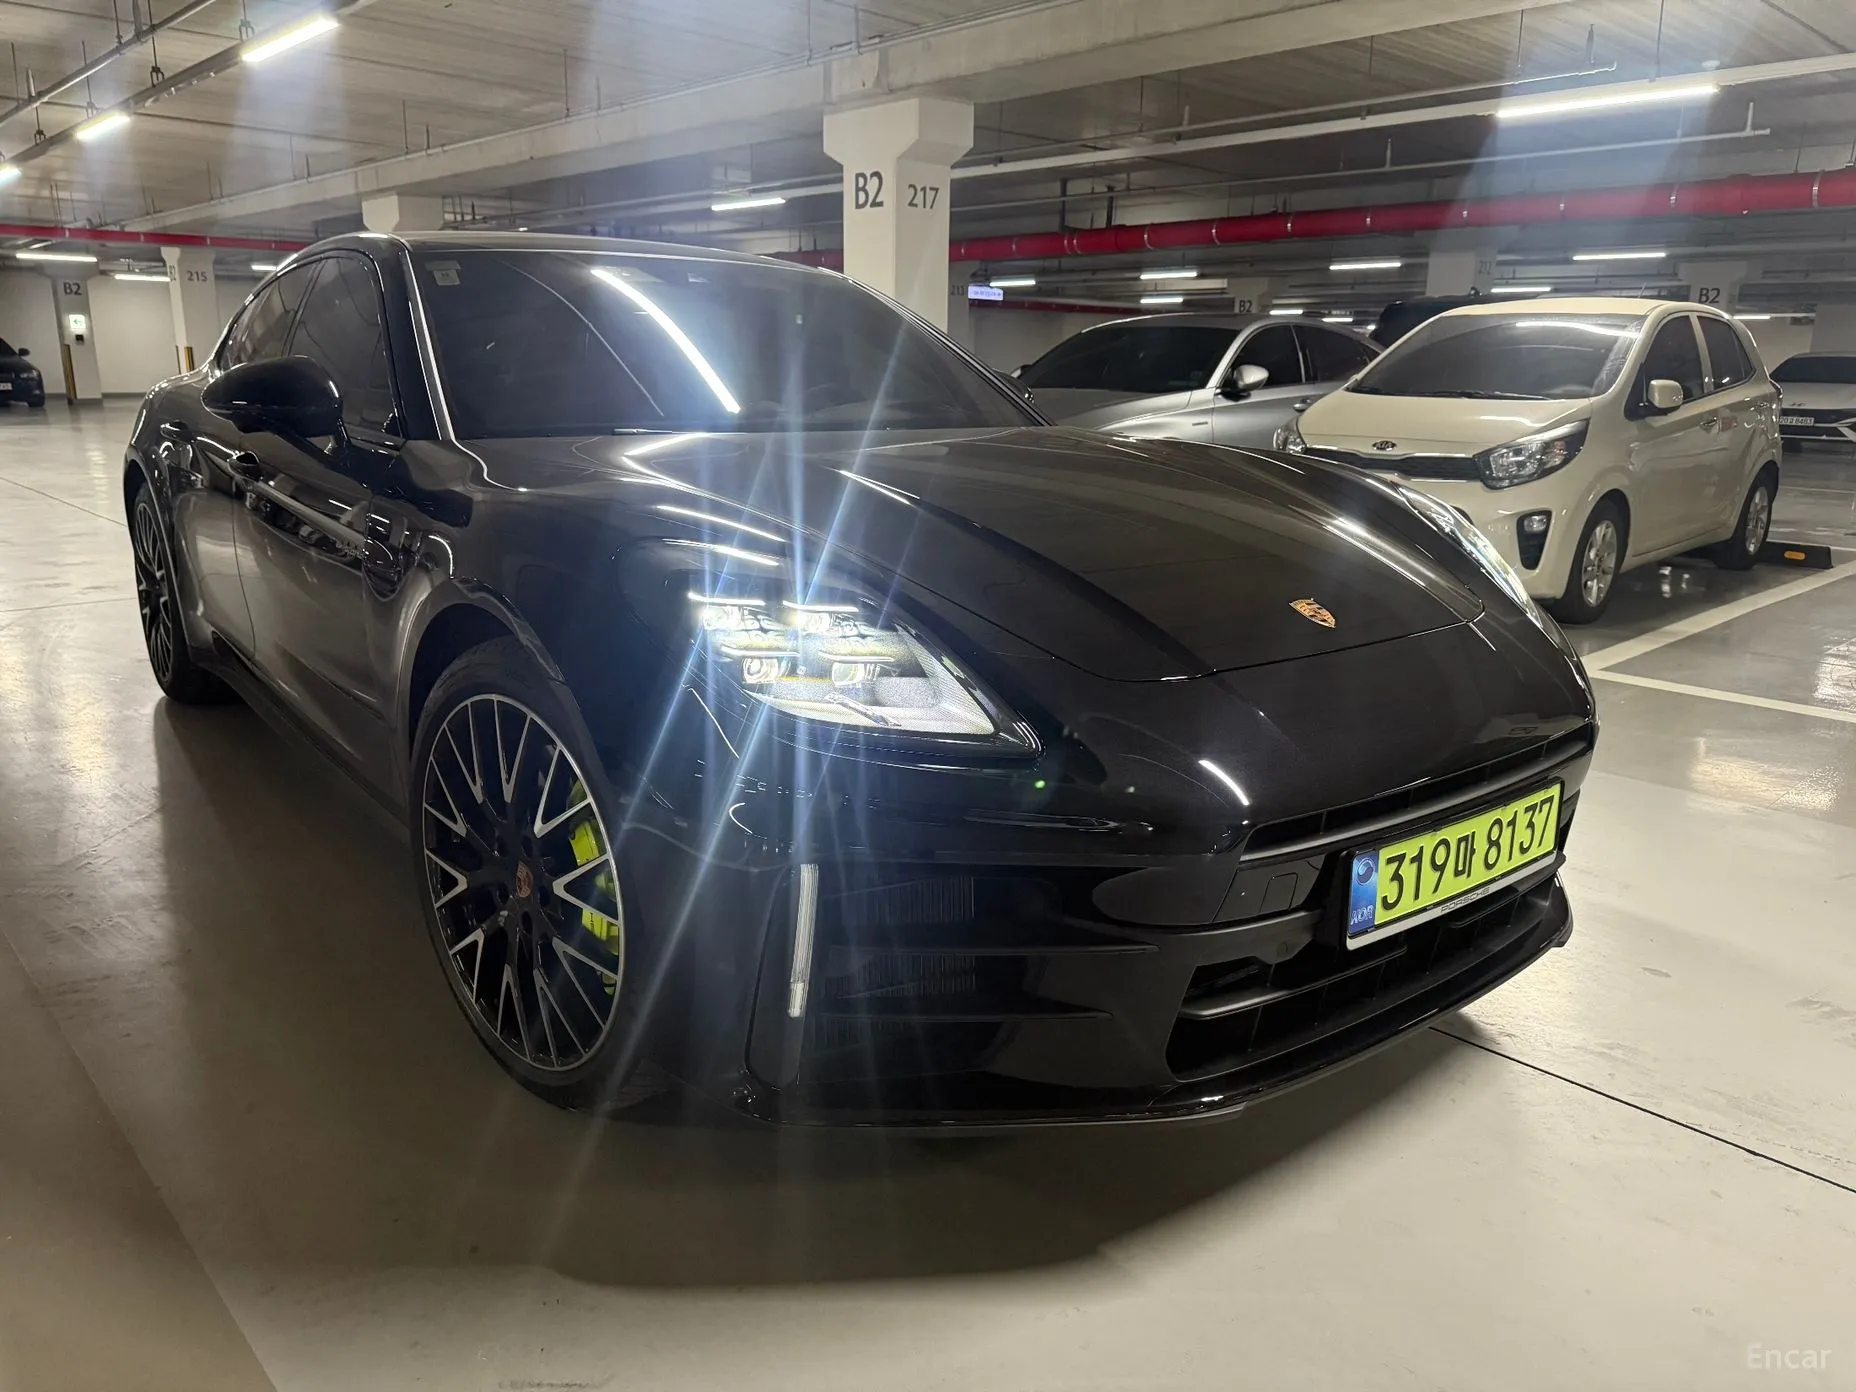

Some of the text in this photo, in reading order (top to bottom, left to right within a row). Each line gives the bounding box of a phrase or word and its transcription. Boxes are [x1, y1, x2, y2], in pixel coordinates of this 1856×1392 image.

[854, 171, 884, 210] B2
[907, 183, 940, 211] 217
[187, 270, 208, 282] 215
[63, 282, 82, 296] B2
[1698, 287, 1721, 304] B2
[1239, 299, 1253, 313] B2
[1381, 794, 1555, 911] 319마 8137
[1441, 886, 1490, 913] PORSCHE
